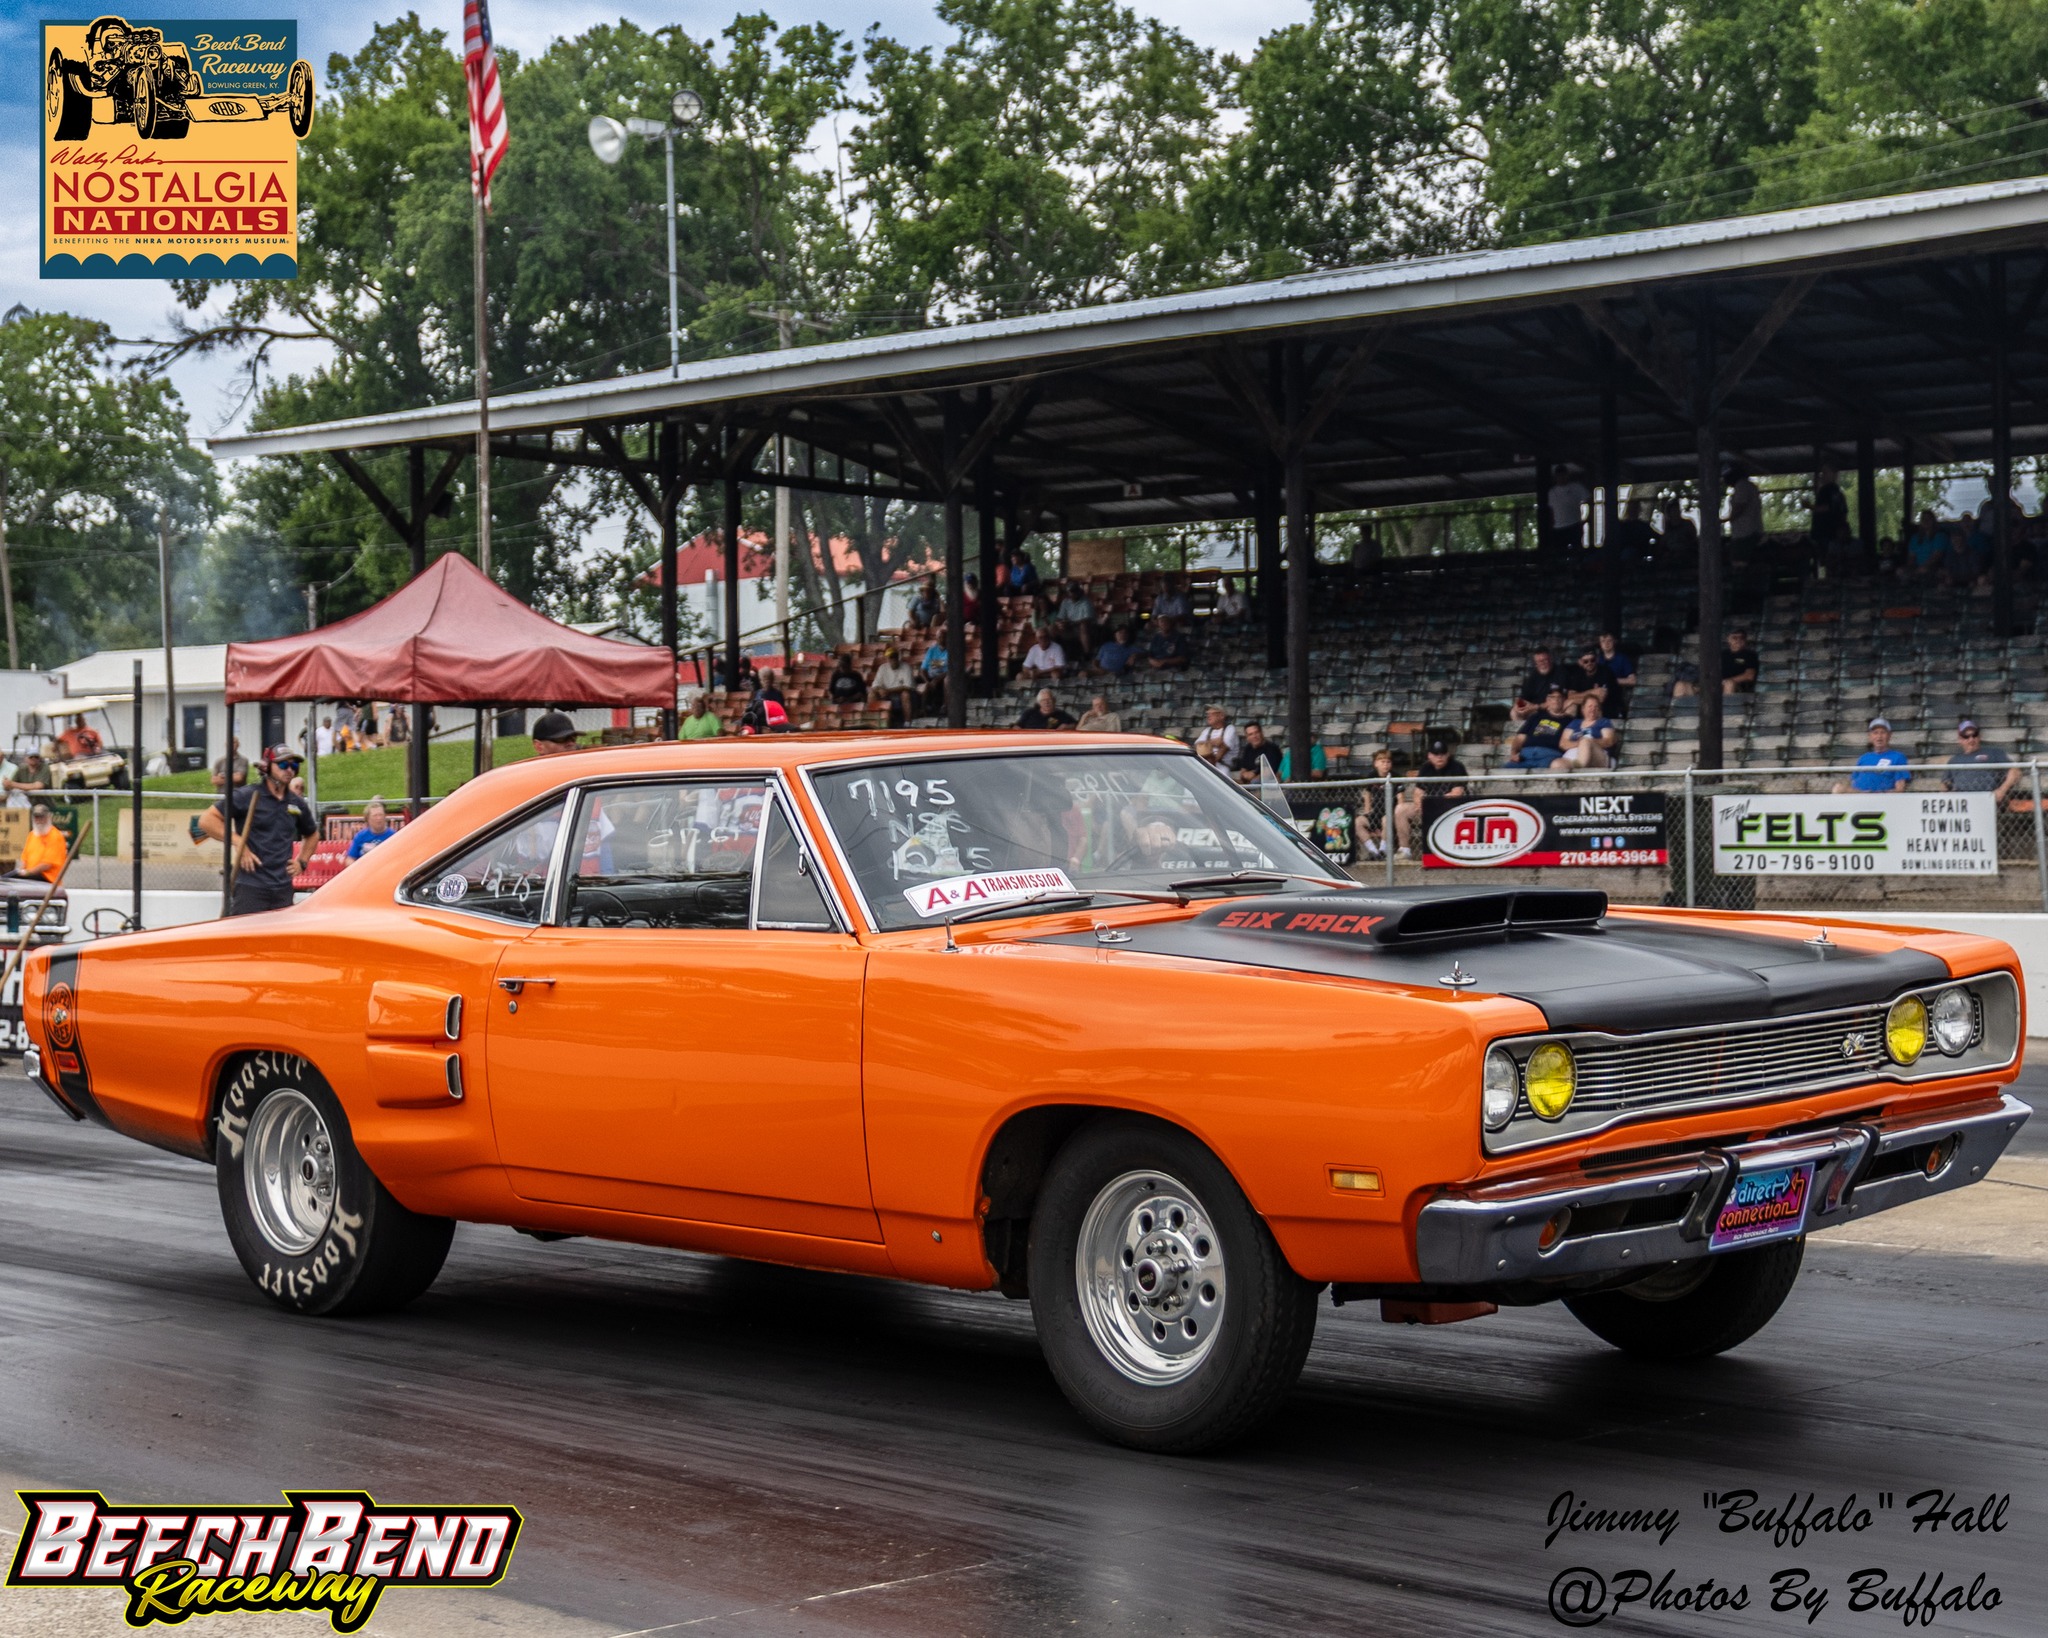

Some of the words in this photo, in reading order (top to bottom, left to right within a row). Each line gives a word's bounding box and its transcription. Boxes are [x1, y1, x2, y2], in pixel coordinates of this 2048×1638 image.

[847, 778, 956, 817] 7195
[1580, 796, 1634, 814] NEXT
[1922, 799, 1969, 814] REPAIR
[1609, 814, 1628, 822] FUEL
[1921, 818, 1972, 834] TOWING
[1454, 811, 1518, 845] ATM
[1736, 811, 1888, 844] FELTS
[1907, 838, 1949, 853] HEAVY
[1952, 837, 1986, 853] HAUL
[1560, 850, 1658, 865] 270-846-3964
[1734, 854, 1874, 870] 270-796-9100
[1901, 858, 1944, 870] BOWLING
[1980, 858, 1992, 870] KY
[982, 872, 1064, 893] TRANSMISSION
[1217, 911, 1286, 929] SIX
[1284, 913, 1386, 935] PACK
[1720, 1201, 1798, 1229] connection
